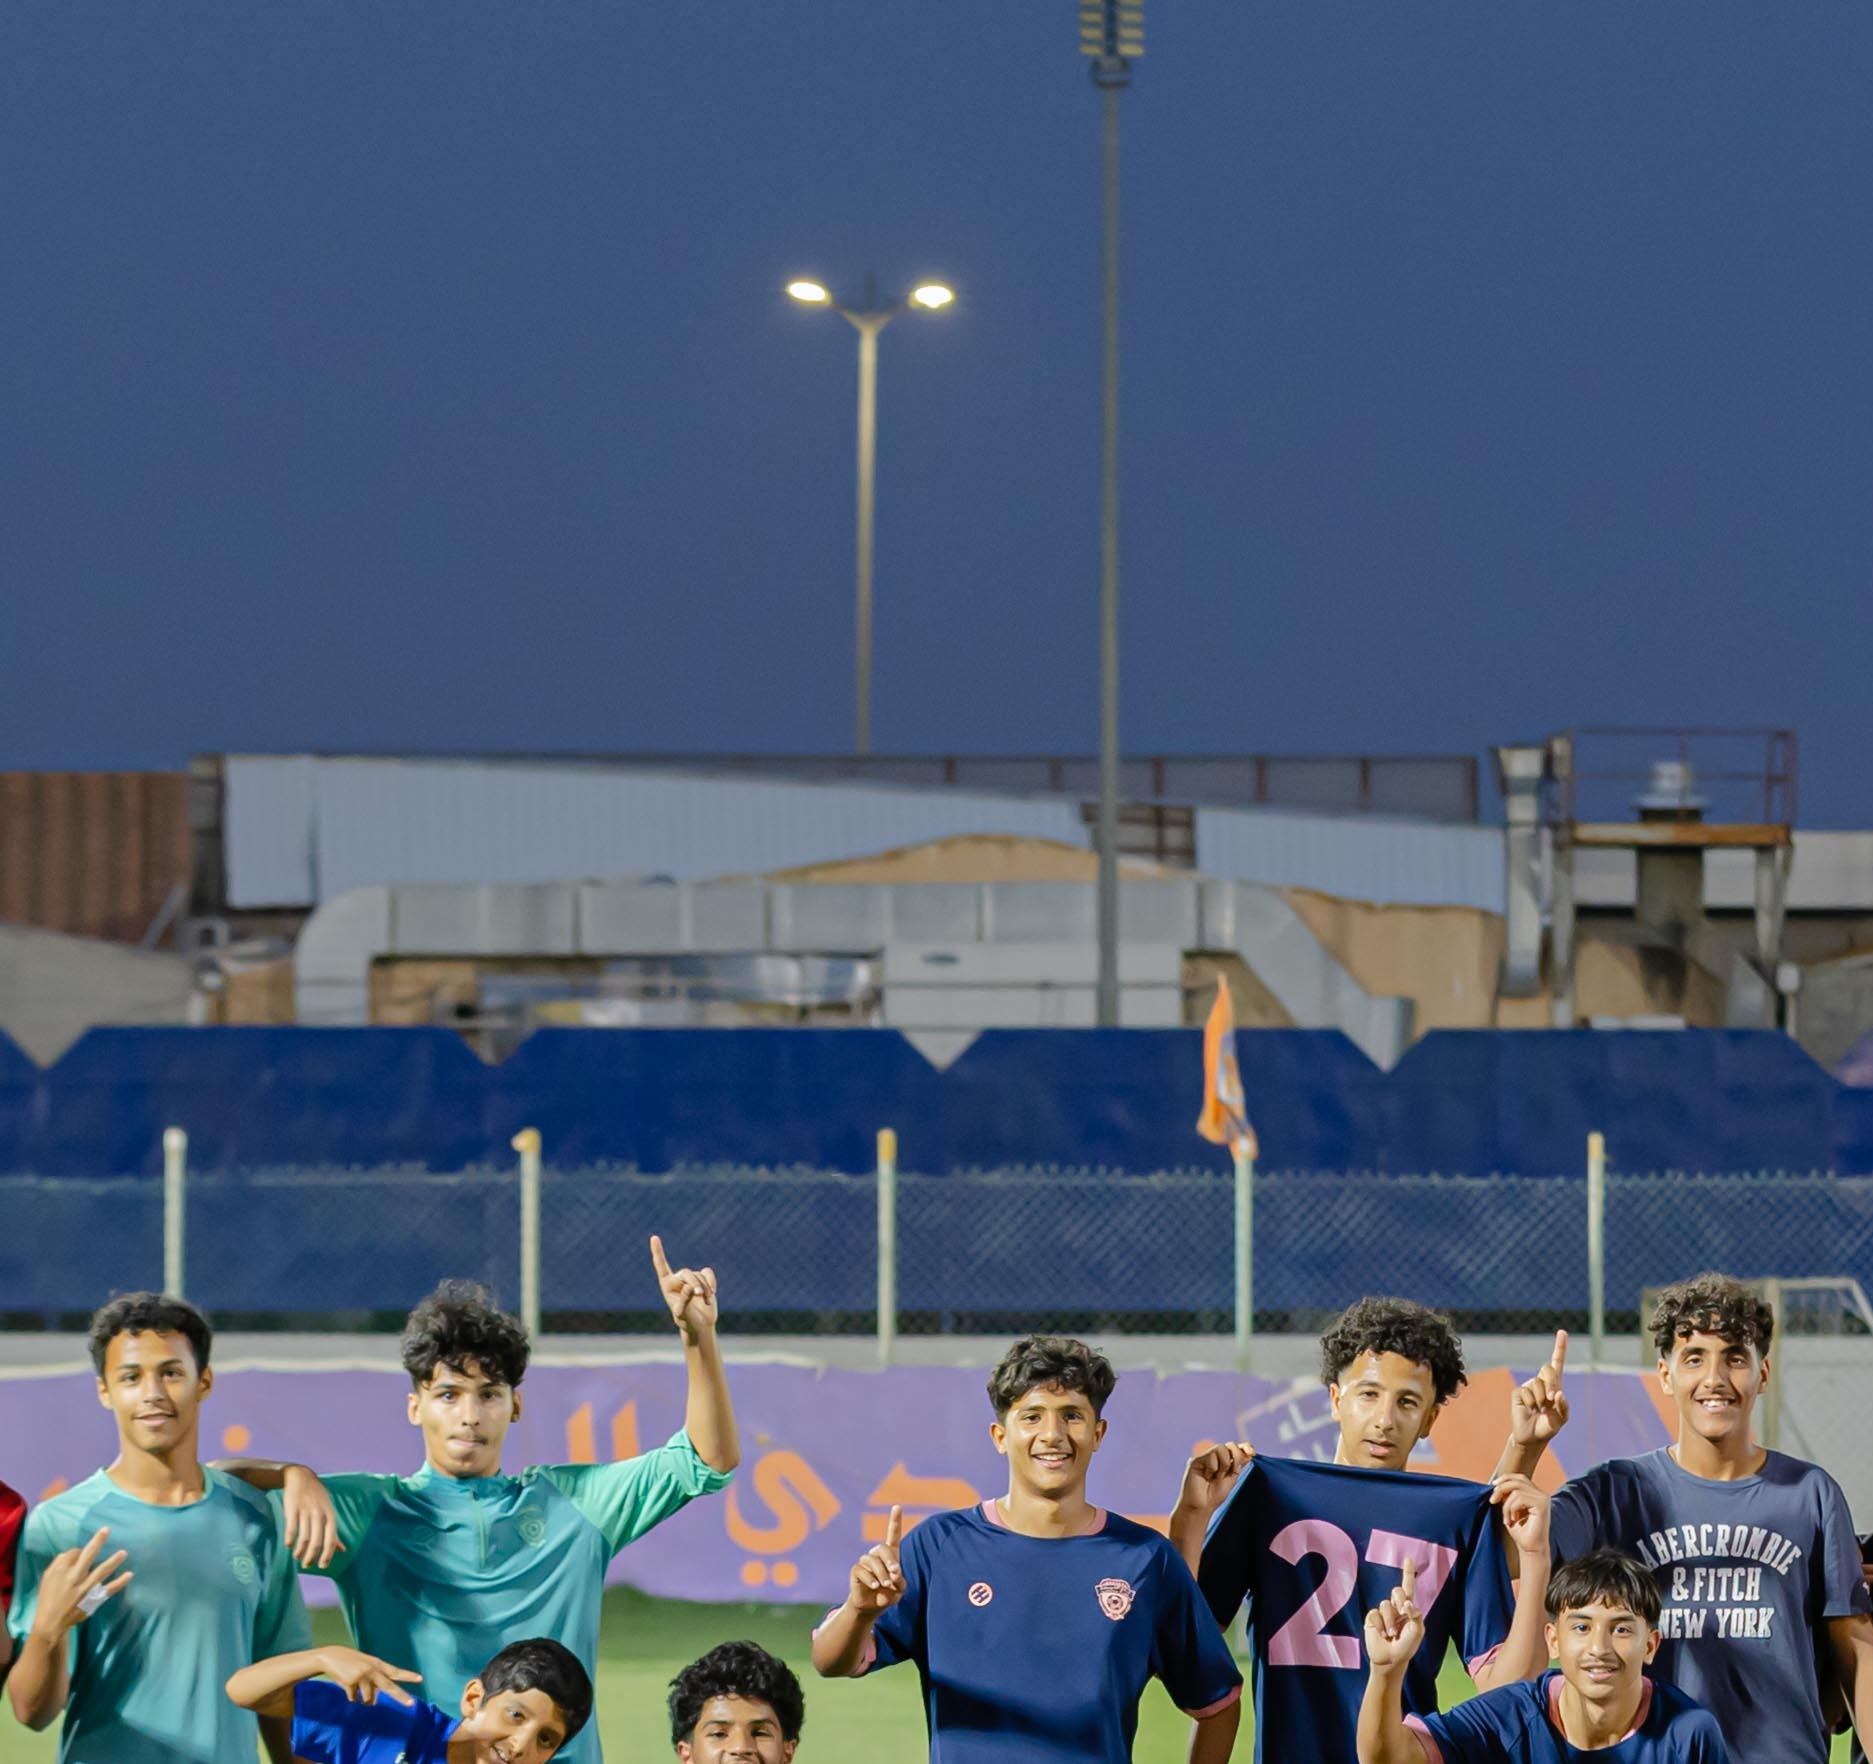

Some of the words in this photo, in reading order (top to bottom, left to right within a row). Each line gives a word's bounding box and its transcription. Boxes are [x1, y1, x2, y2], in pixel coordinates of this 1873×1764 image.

[1636, 1523, 1802, 1576] ABERCROMBIE
[1268, 1519, 1458, 1669] 27
[1671, 1566, 1689, 1601] &
[1692, 1566, 1762, 1602] FITCH
[1658, 1608, 1707, 1640] NEW
[1715, 1607, 1775, 1639] YORK
